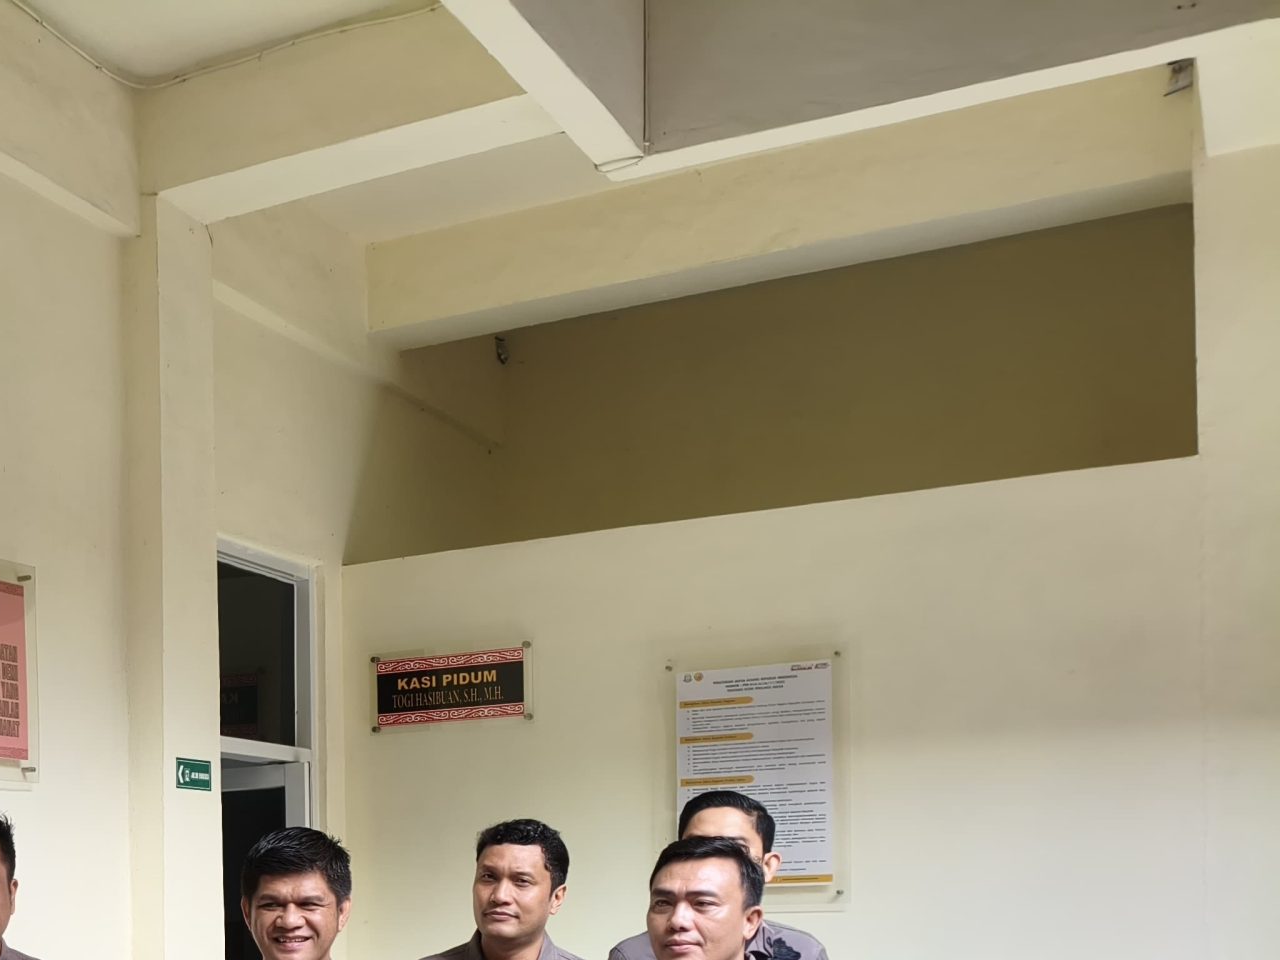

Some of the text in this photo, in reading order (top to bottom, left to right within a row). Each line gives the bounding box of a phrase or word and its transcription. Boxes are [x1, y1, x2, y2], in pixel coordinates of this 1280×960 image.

[397, 669, 497, 690] KASI PIDUM
[391, 692, 416, 709] TOGI
